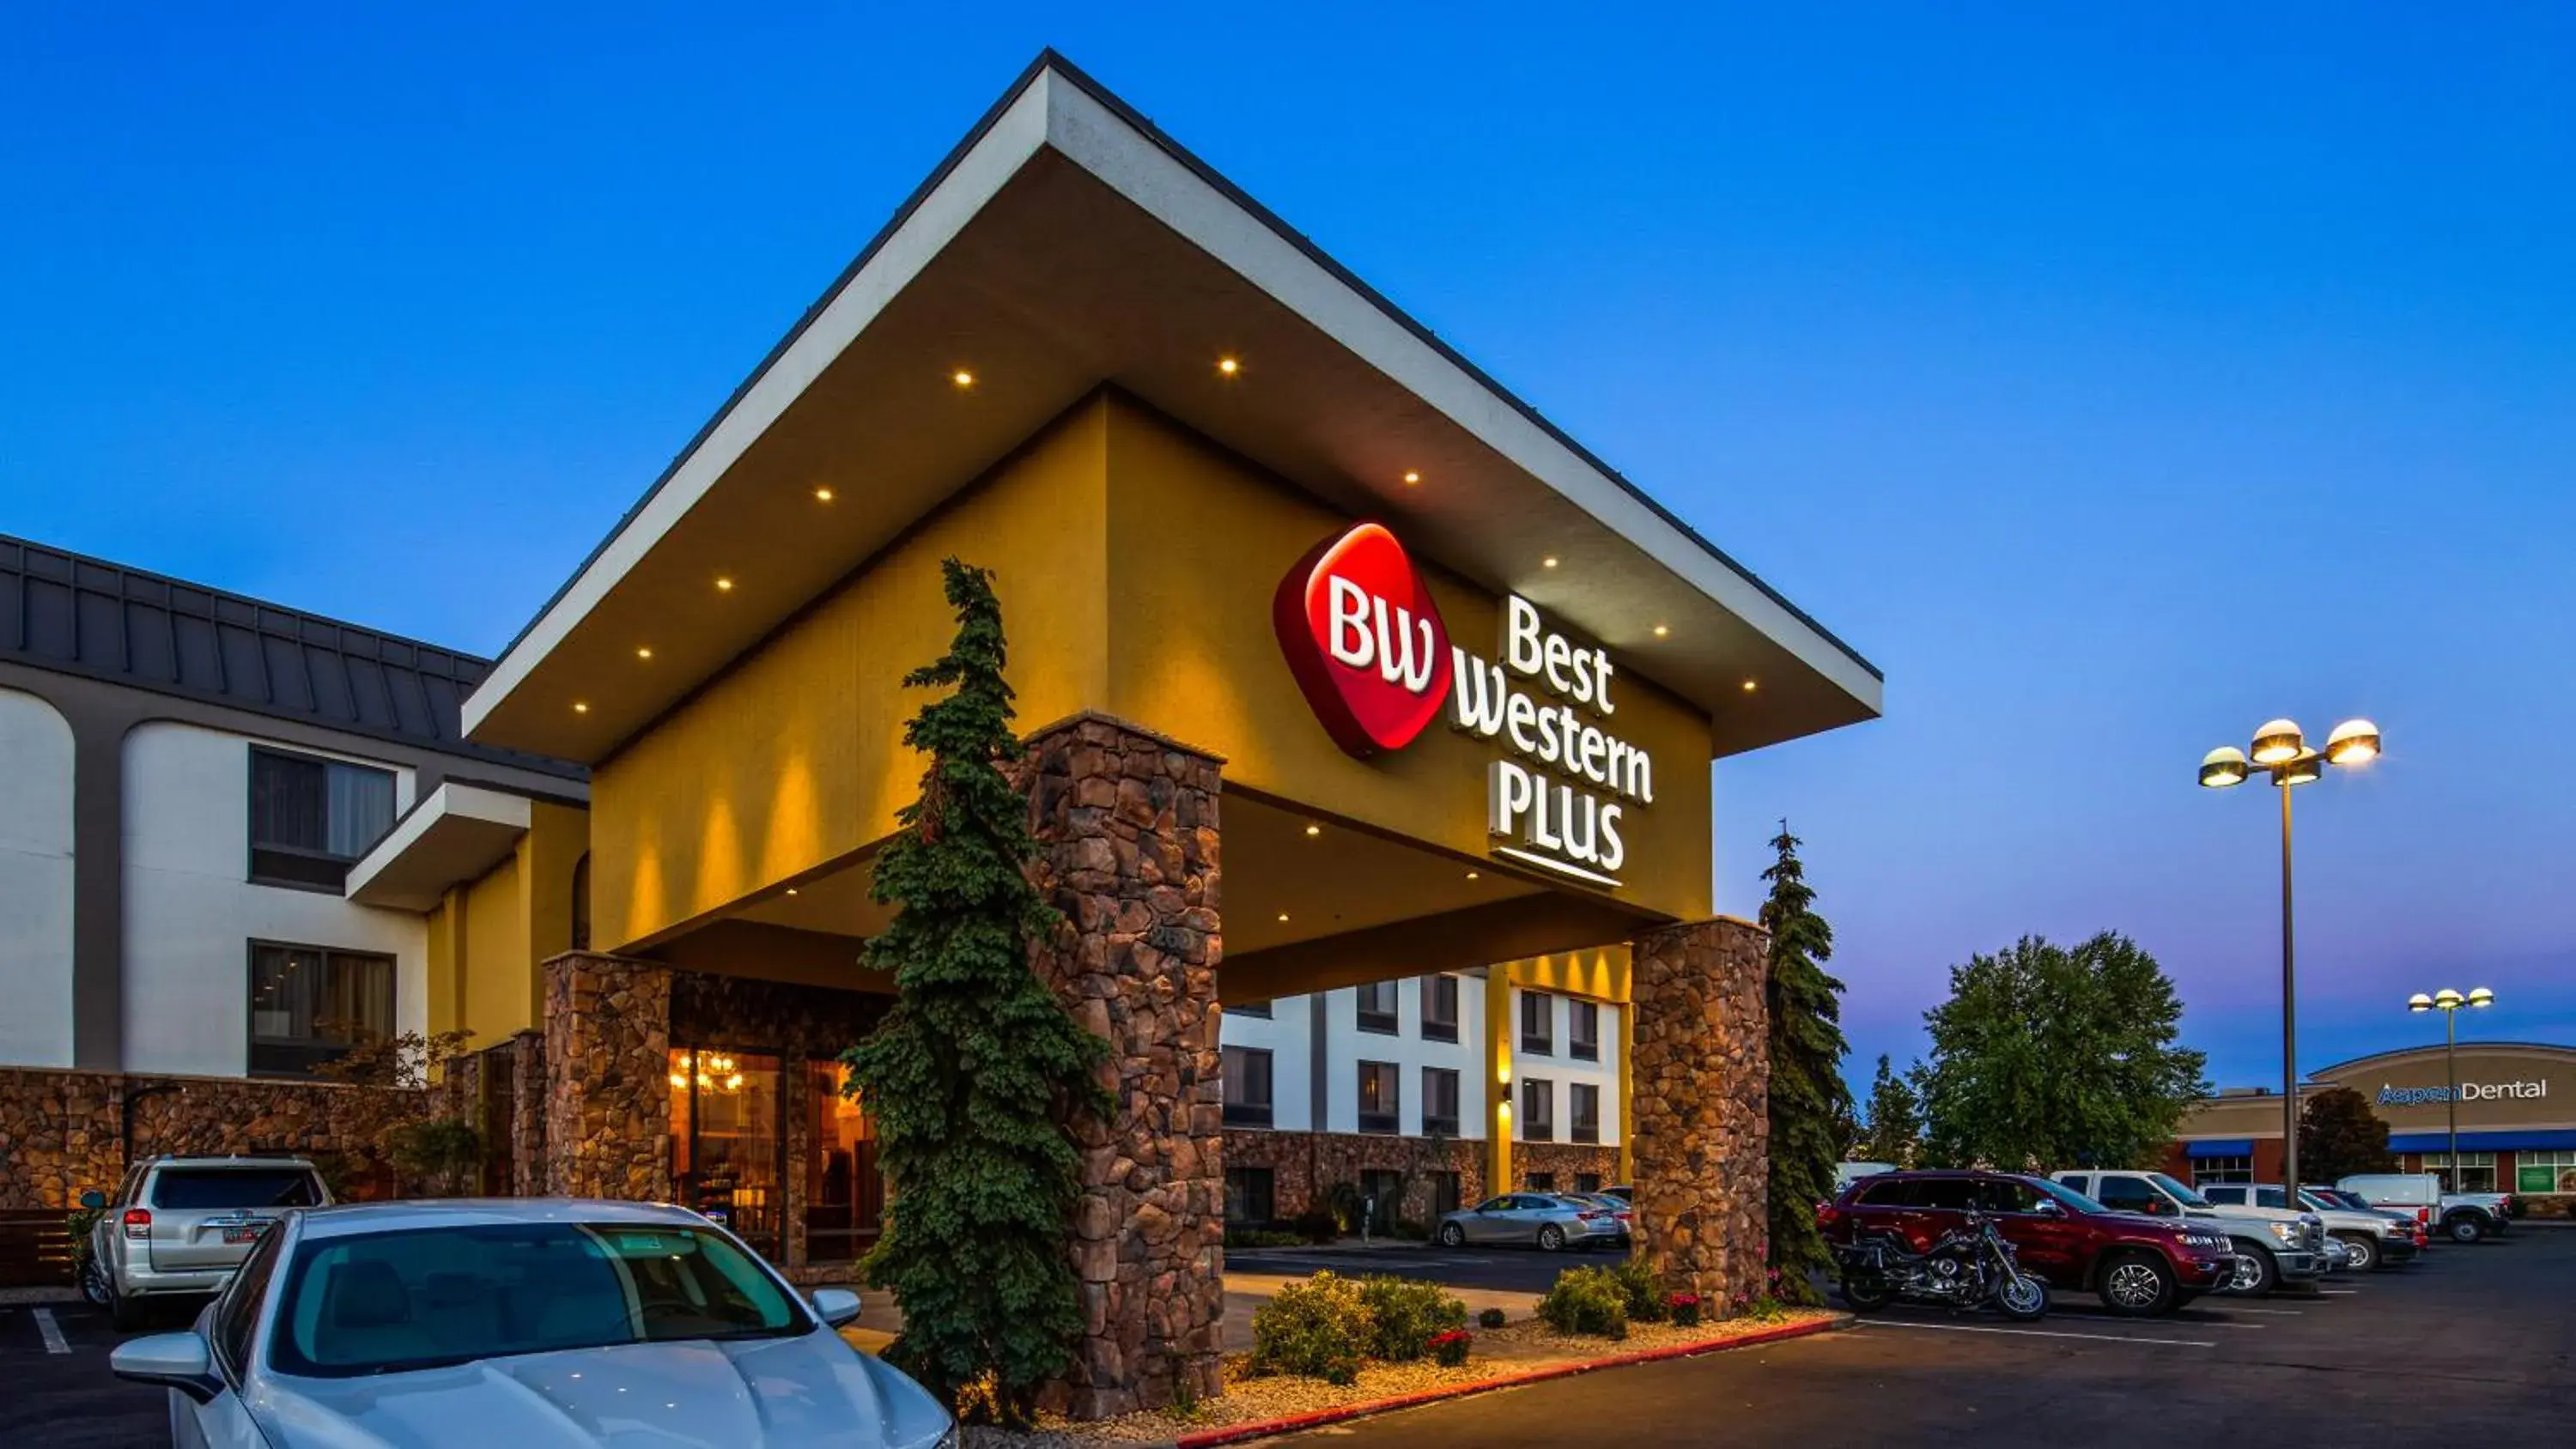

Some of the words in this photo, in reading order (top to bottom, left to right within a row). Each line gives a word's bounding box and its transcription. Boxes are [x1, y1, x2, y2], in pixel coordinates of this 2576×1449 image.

[1329, 574, 1433, 694] BW
[1509, 594, 1614, 715] Best
[1453, 646, 1653, 803] Western
[1500, 760, 1623, 871] PLUS
